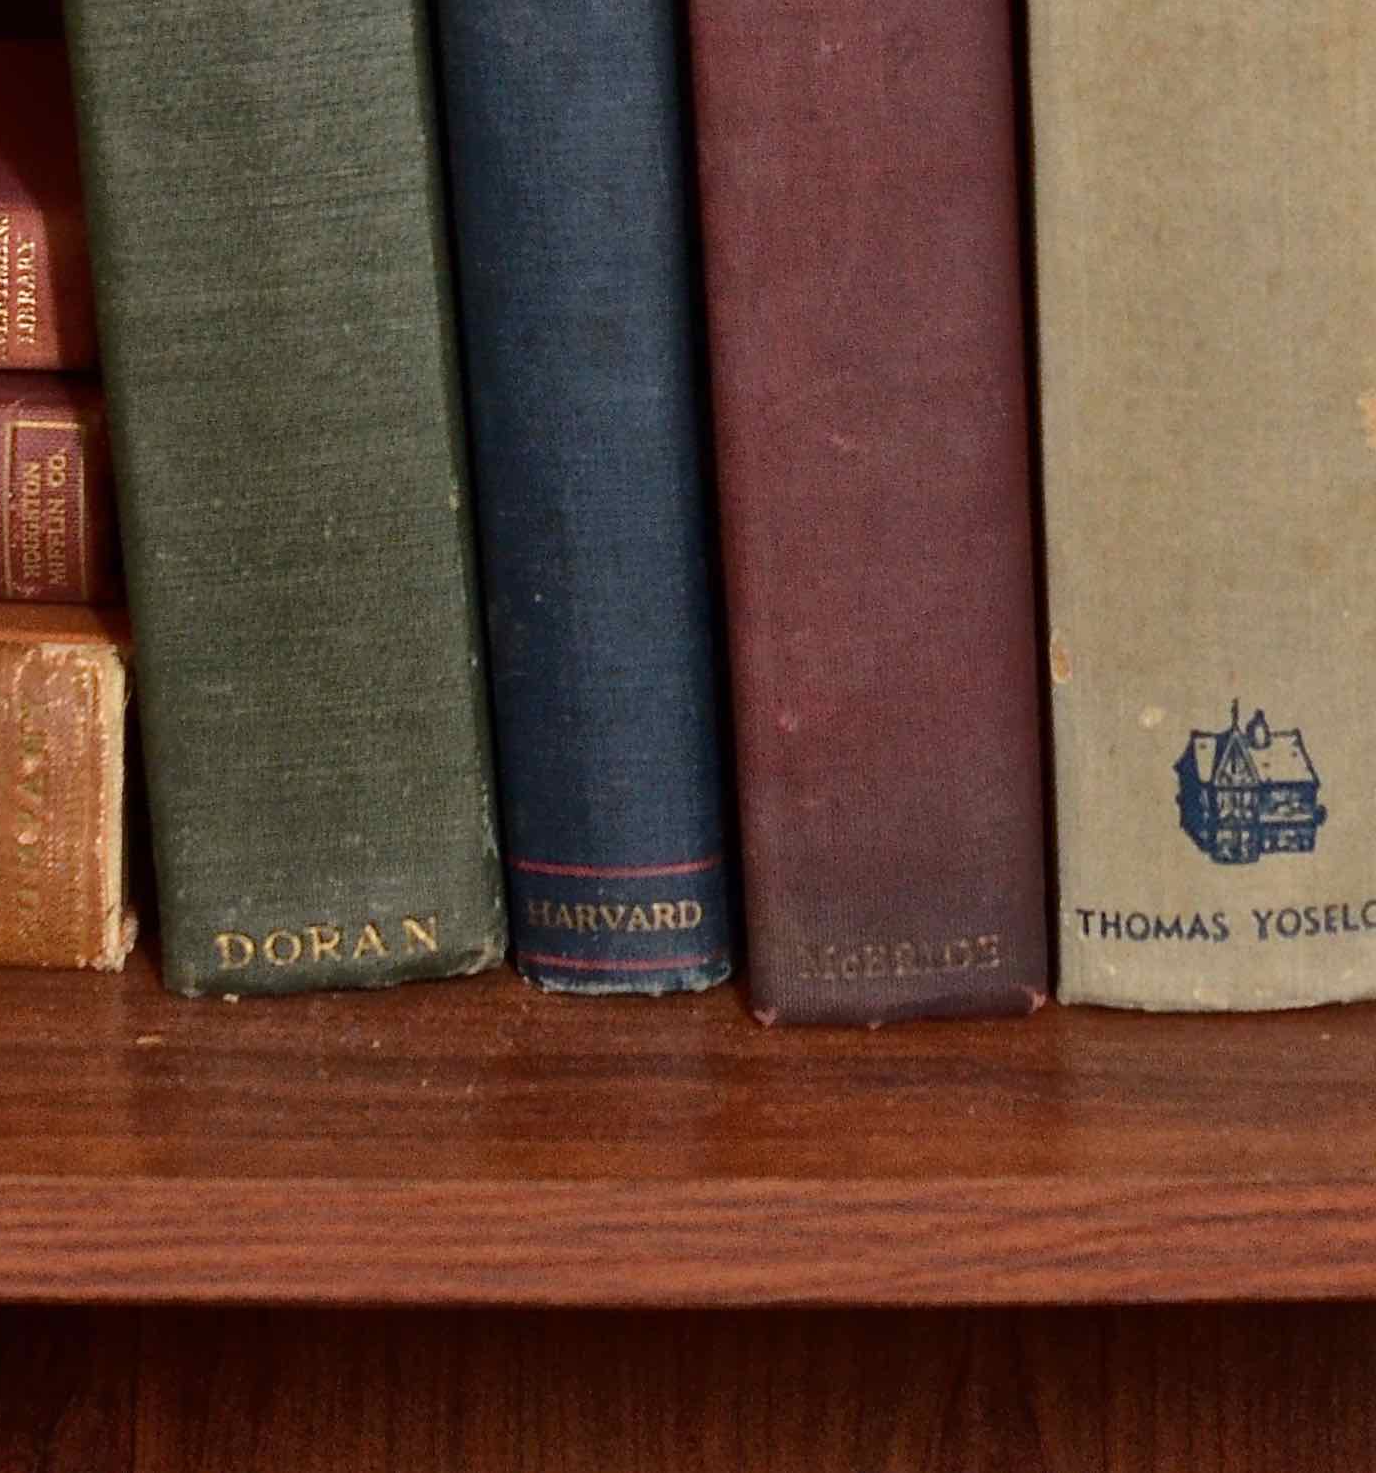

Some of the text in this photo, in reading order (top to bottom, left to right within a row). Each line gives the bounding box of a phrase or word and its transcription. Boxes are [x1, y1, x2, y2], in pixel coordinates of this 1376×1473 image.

[527, 898, 704, 935] HARVARD
[1075, 907, 1230, 943] THOMAS
[215, 911, 441, 971] DORAN
